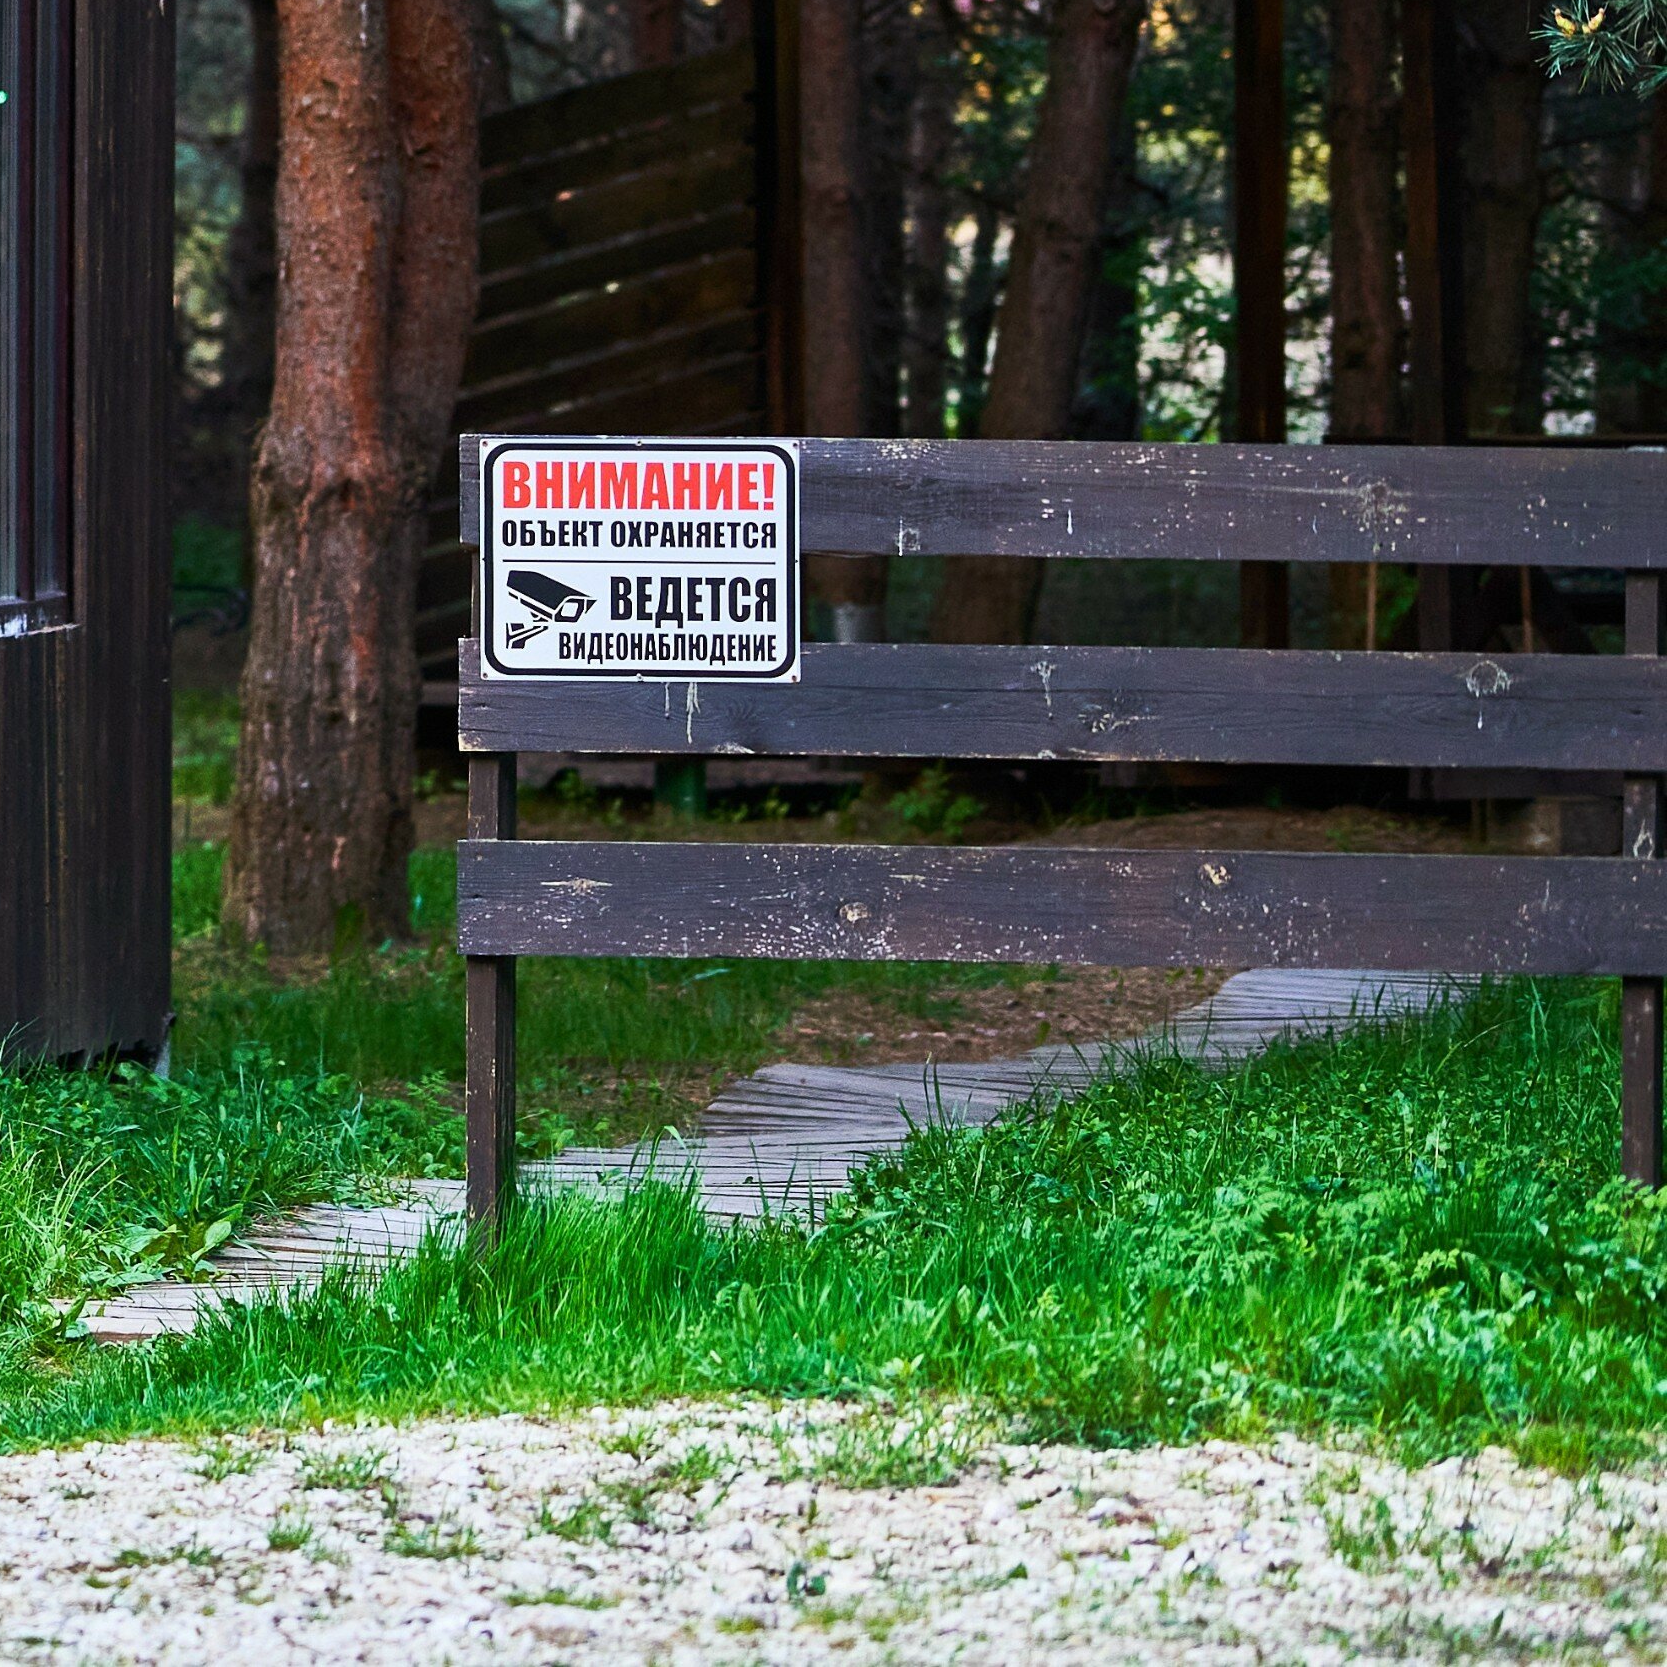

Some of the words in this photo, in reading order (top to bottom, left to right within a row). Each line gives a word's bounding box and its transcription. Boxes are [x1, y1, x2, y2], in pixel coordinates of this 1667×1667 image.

[502, 461, 775, 511] ВНИМАНИЕ!
[501, 519, 604, 548] ОБЪЕКТ
[610, 520, 777, 549] ОХРАНЯЕТСЯ
[610, 575, 777, 630] ВЕДЕТСЯ
[558, 632, 777, 667] ВИДЕОНАБЛЮДЕНИЕ
